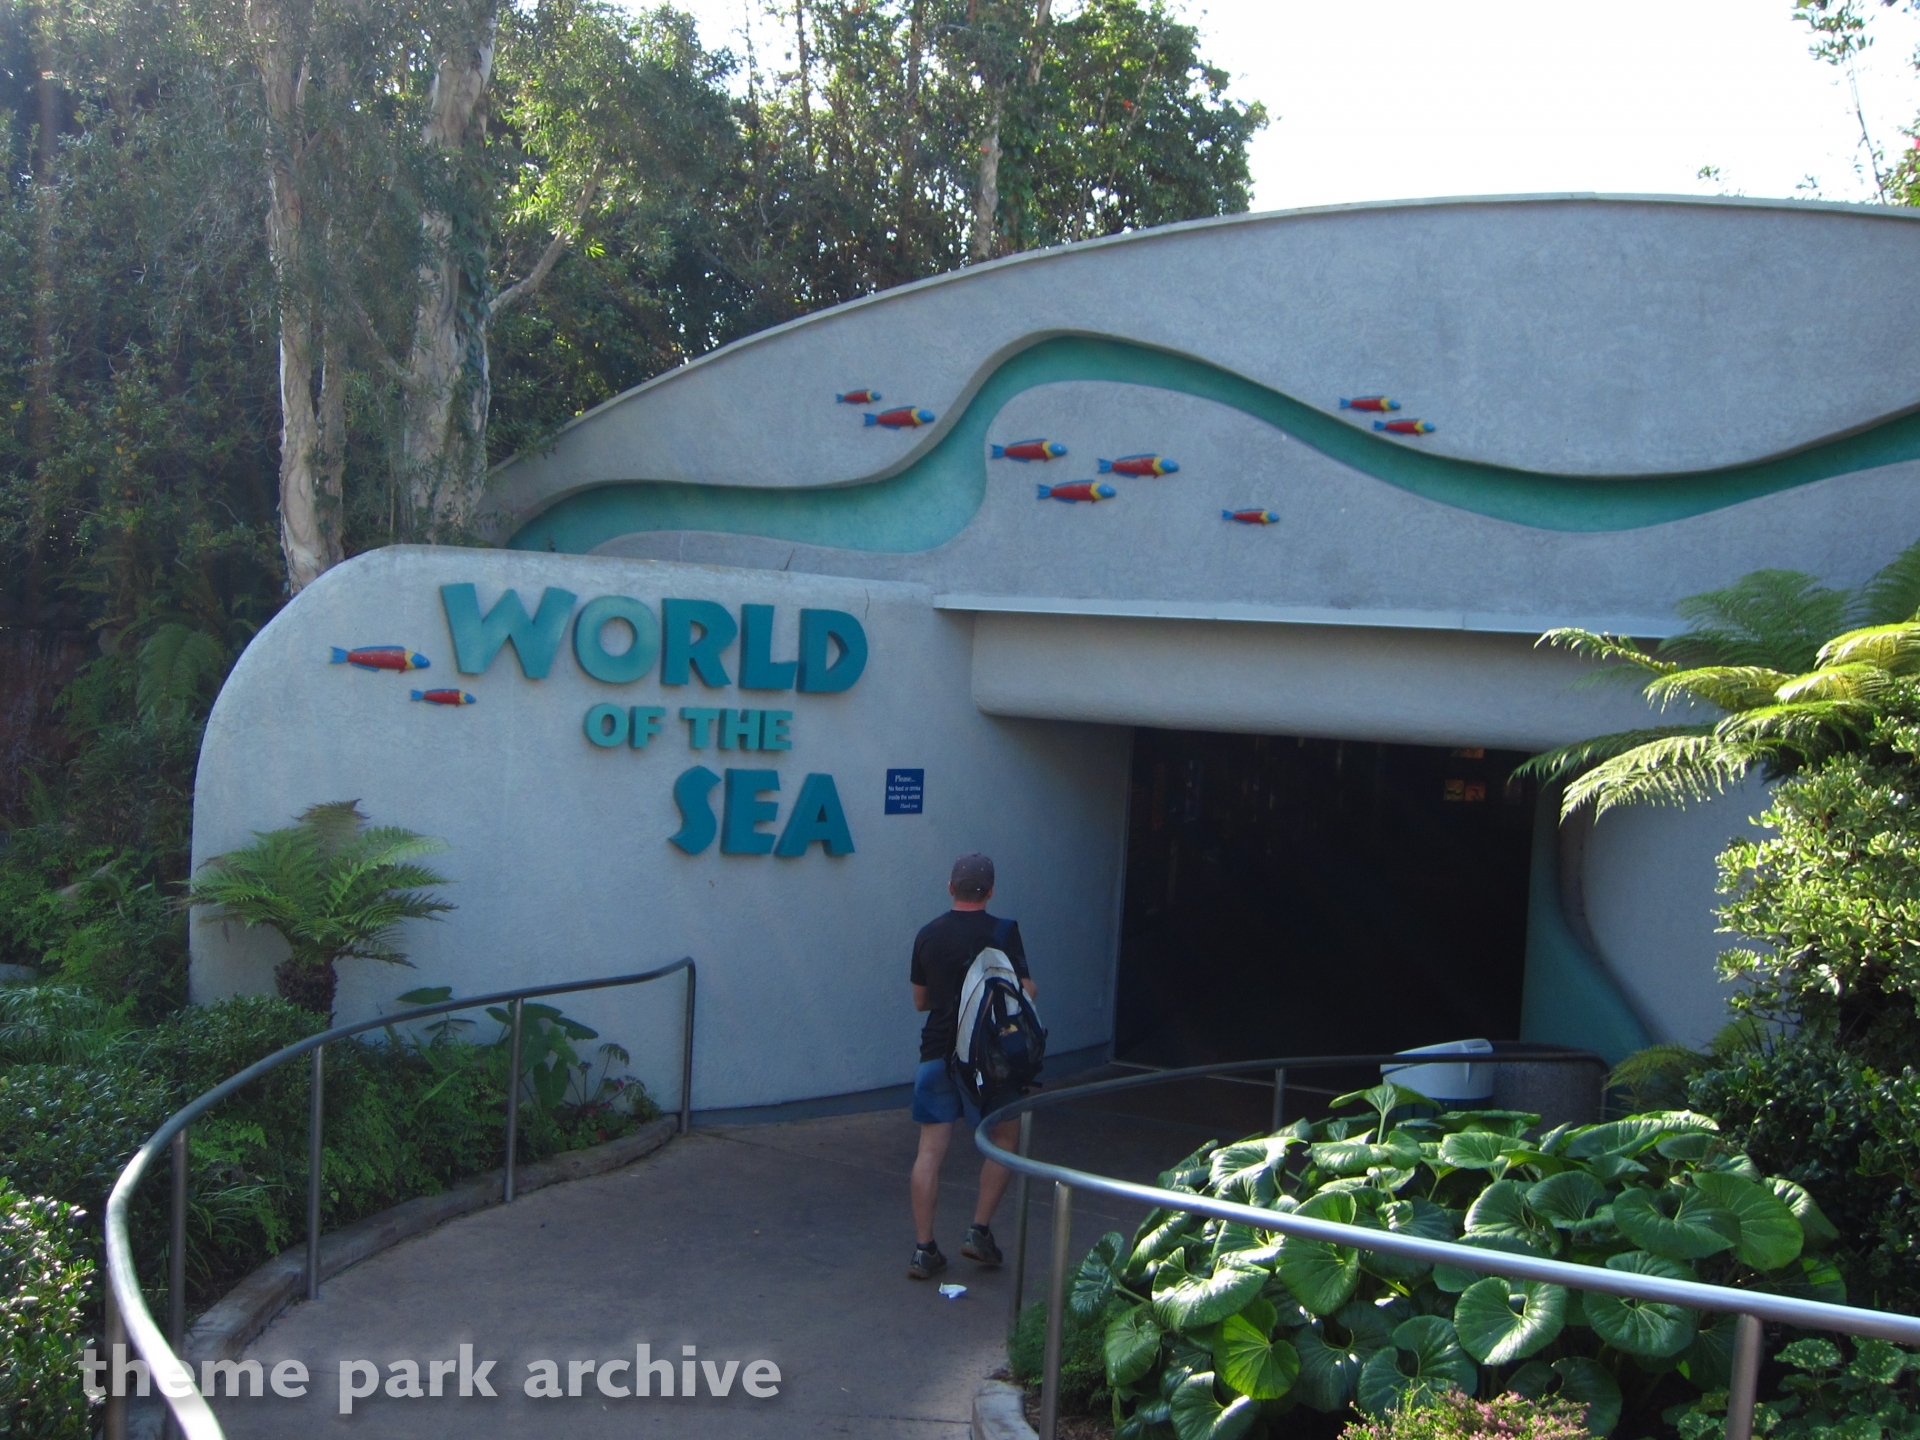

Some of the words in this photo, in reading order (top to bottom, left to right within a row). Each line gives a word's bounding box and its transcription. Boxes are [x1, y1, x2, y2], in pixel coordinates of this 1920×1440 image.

[440, 583, 868, 693] WORLD
[584, 702, 666, 749] OF
[680, 707, 793, 751] THE
[668, 765, 855, 857] SEA
